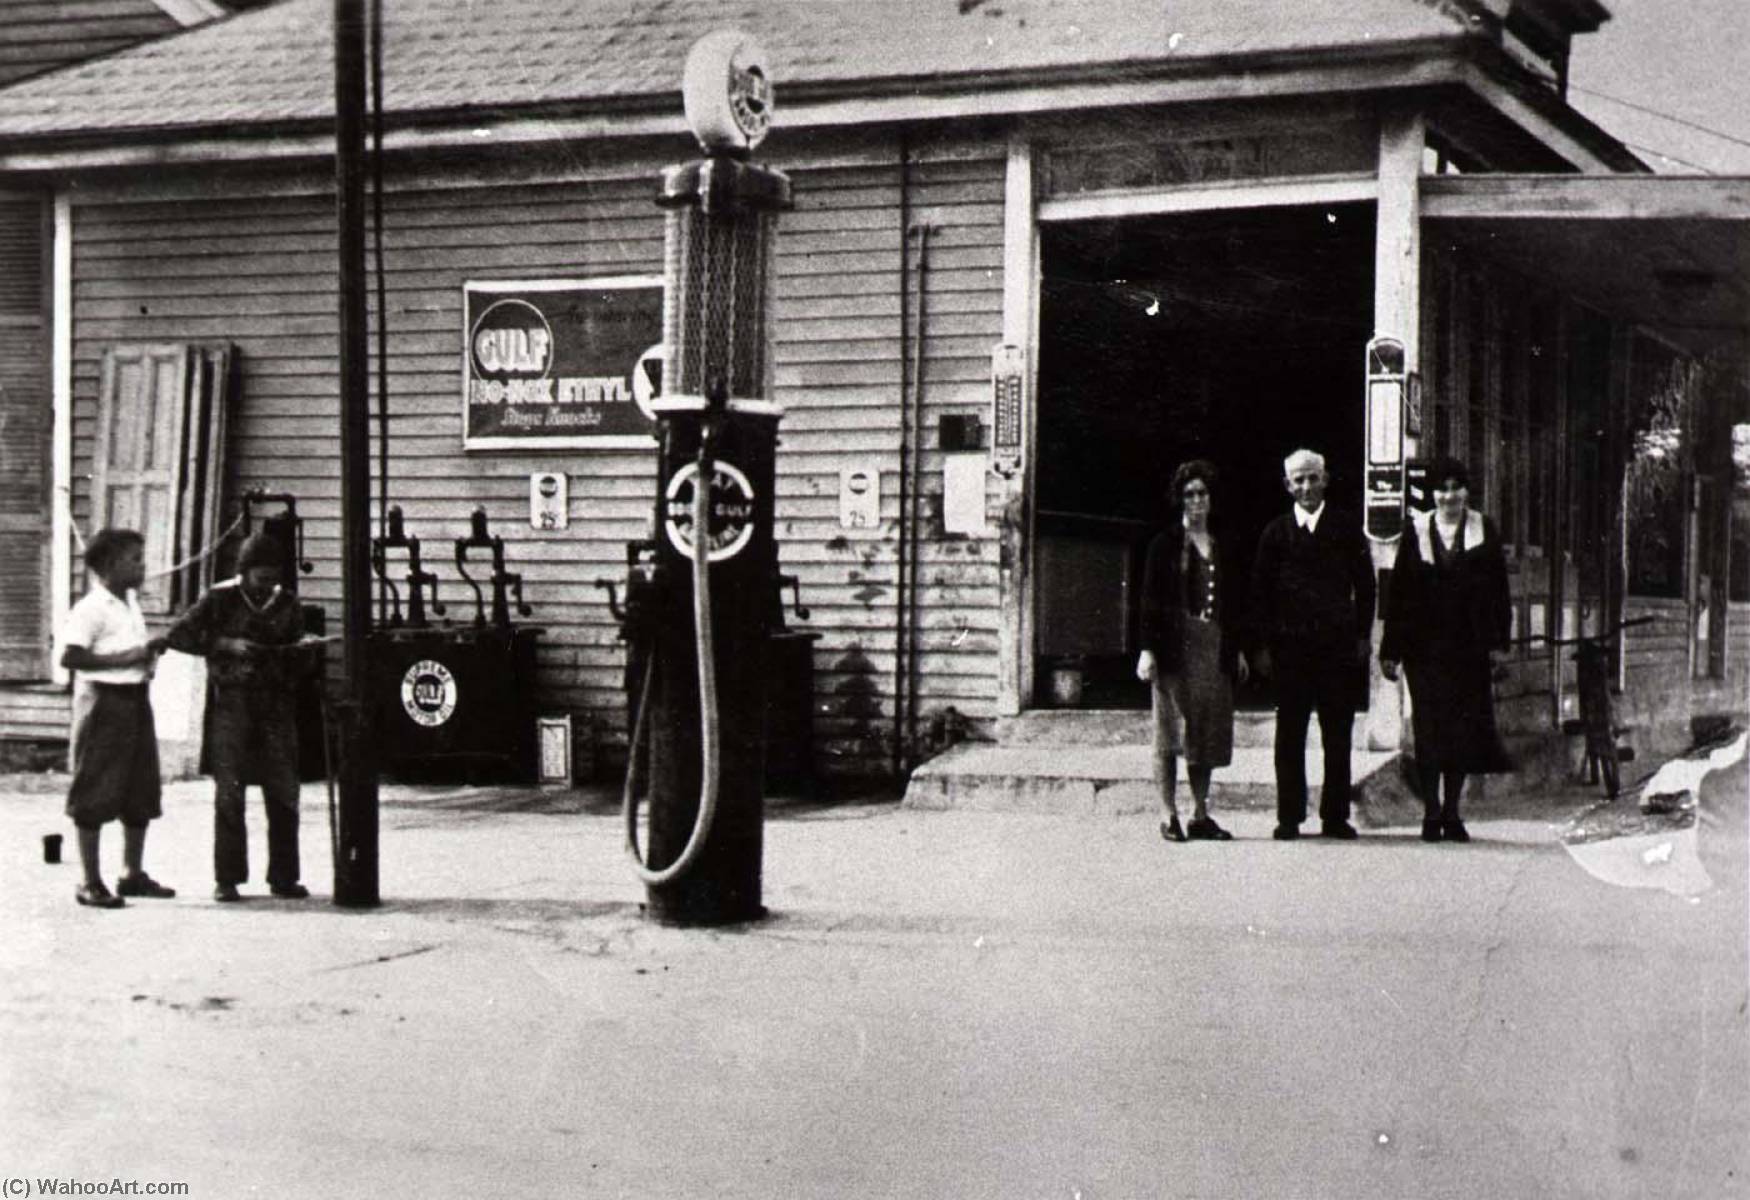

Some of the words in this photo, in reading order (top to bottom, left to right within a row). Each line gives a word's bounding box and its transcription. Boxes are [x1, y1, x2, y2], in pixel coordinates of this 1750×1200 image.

[474, 328, 549, 372] GULF
[470, 379, 554, 404] NO-NOX
[558, 376, 632, 402] ETHYL
[715, 503, 751, 517] GULF
[415, 683, 443, 704] GULF
